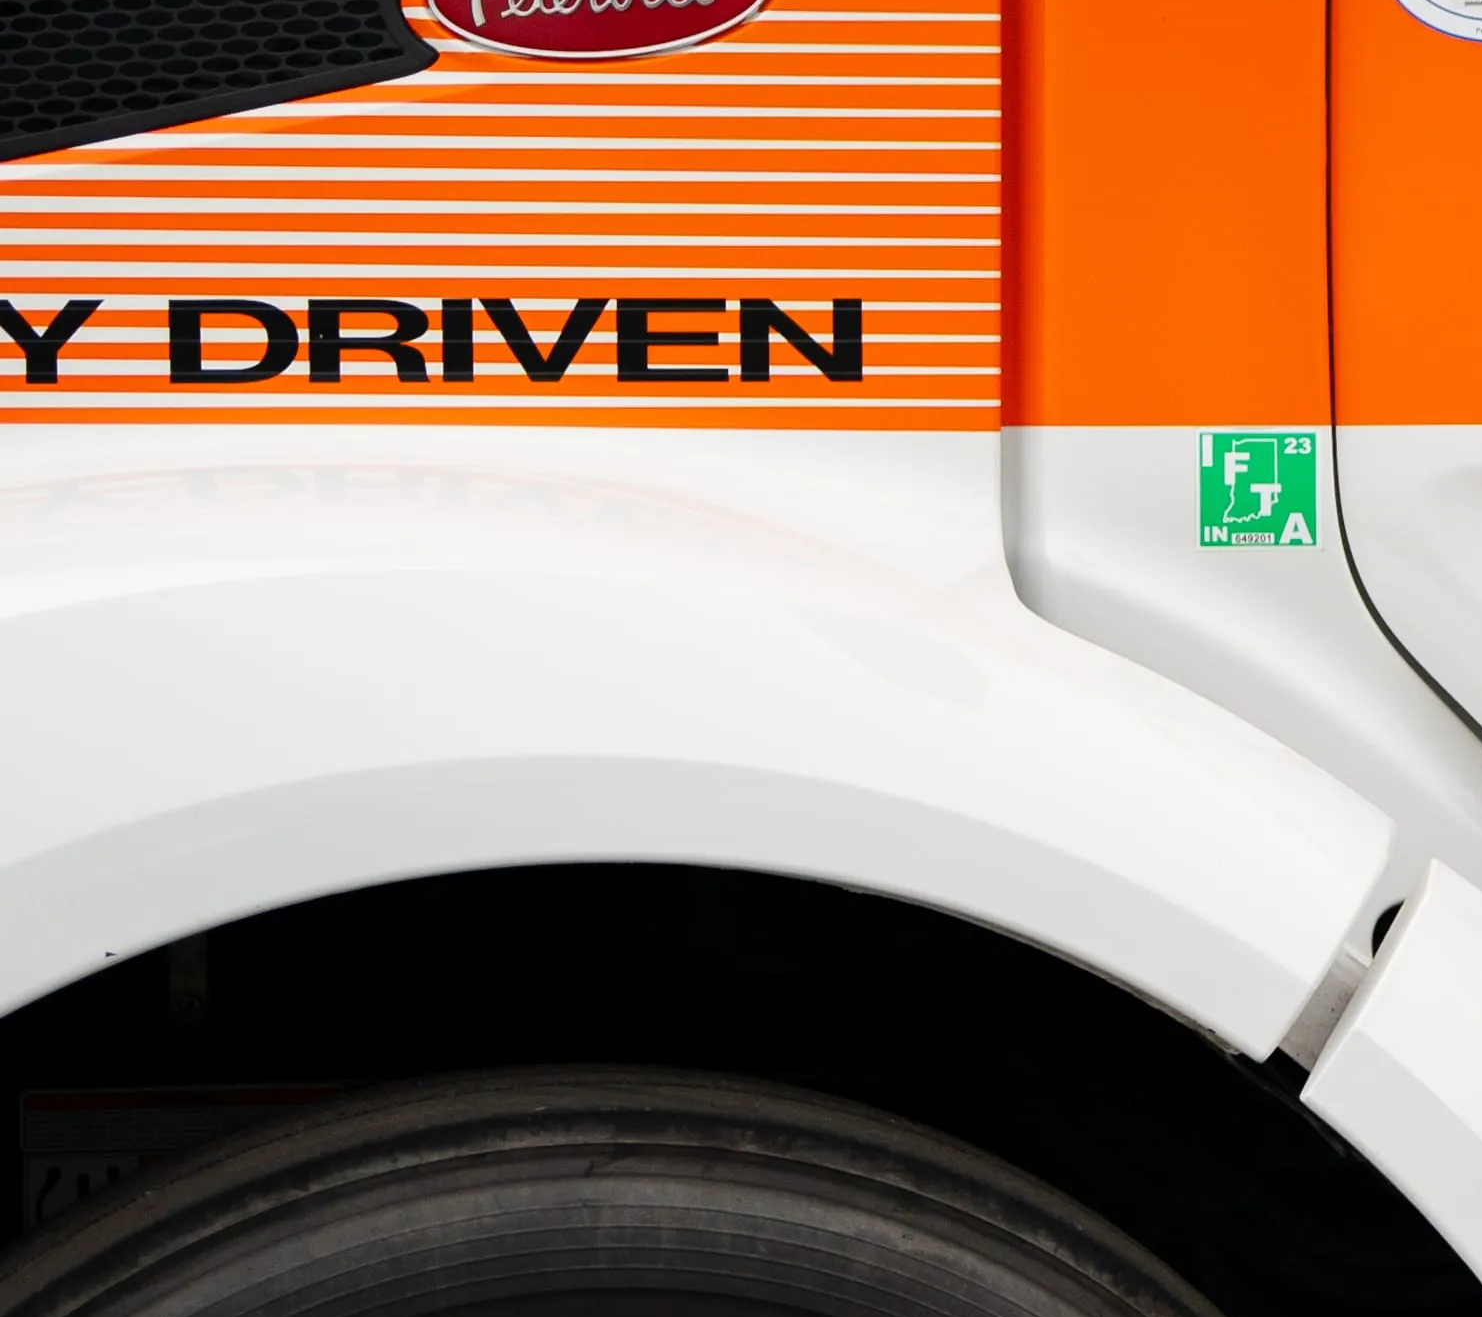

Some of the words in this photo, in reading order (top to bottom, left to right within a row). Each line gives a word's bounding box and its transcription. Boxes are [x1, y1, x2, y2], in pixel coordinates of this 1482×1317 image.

[169, 298, 863, 383] DRIVEN
[1284, 437, 1312, 454] 23
[1203, 526, 1229, 543] IN
